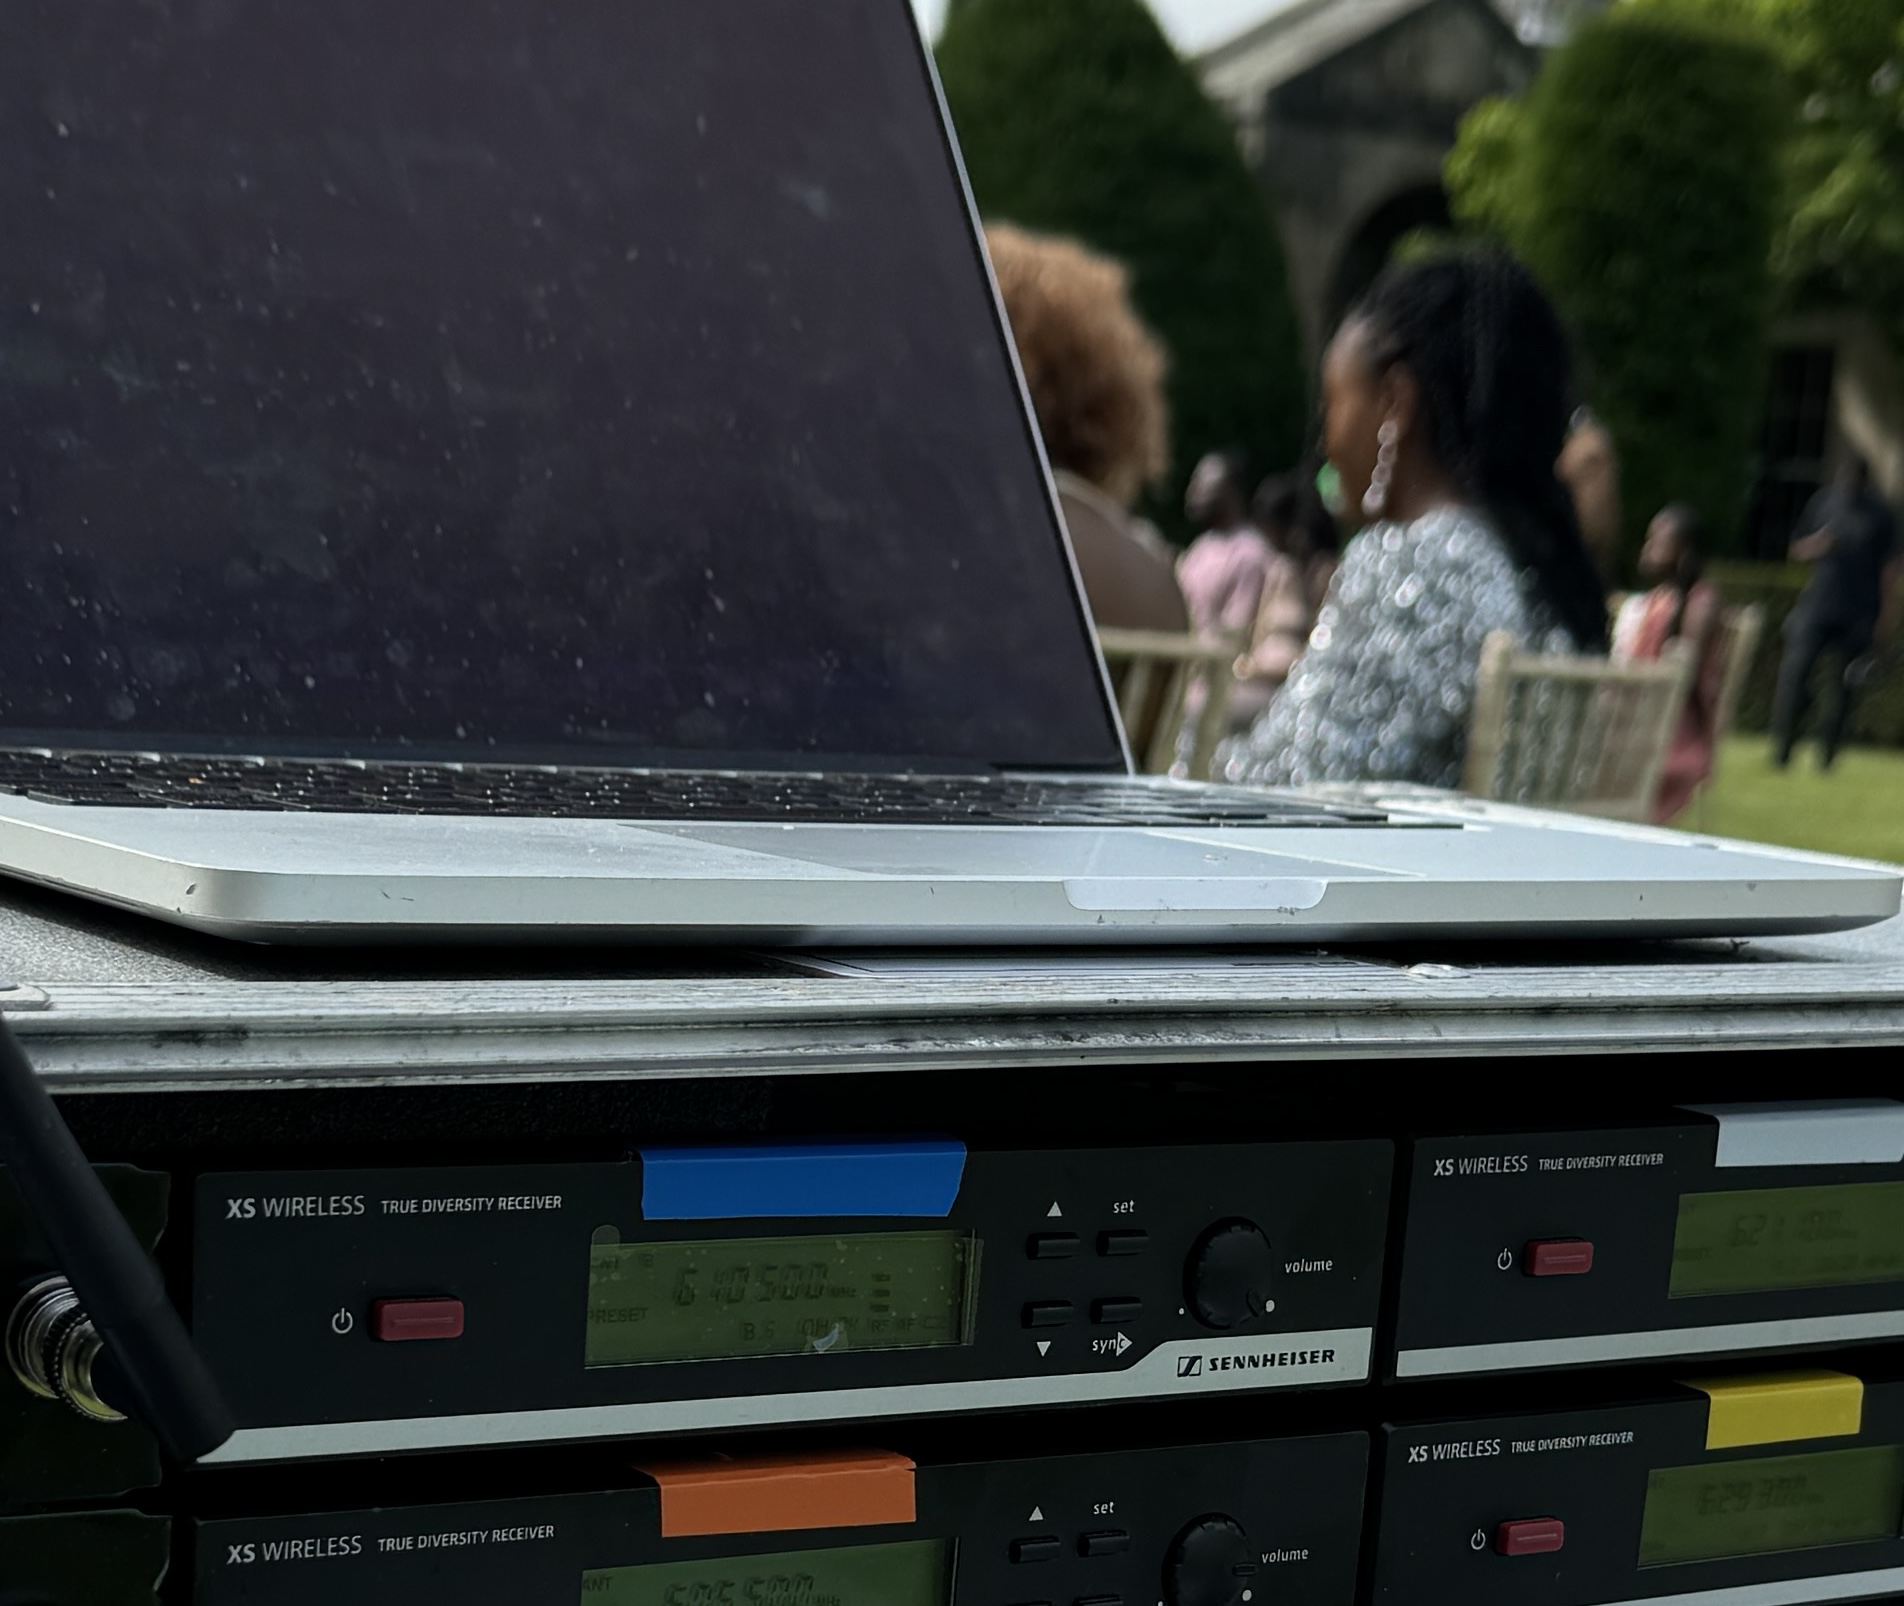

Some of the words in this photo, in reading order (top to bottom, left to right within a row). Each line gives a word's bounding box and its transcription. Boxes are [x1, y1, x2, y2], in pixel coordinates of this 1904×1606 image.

[1433, 1158, 1454, 1177] XS
[1458, 1155, 1528, 1175] WIRELESS
[1538, 1157, 1564, 1171] TRUE
[1566, 1155, 1616, 1170] DIVERSITY
[1617, 1153, 1664, 1167] RECEIVER
[226, 1197, 256, 1219] XS
[262, 1195, 365, 1218] WIRELESS
[381, 1199, 418, 1214] TRUE
[422, 1197, 495, 1213] DIVERSITY
[498, 1195, 562, 1210] RECEIVER
[1113, 1199, 1135, 1214] set
[1284, 1258, 1333, 1274] volume
[1208, 1349, 1335, 1372] SENNHEISER
[1408, 1445, 1429, 1464] XS
[1432, 1438, 1501, 1461] WIRELESS
[1511, 1439, 1536, 1454] TRUE
[1537, 1435, 1588, 1451] DIVERSITY
[1588, 1431, 1634, 1446] RECEIVER
[1093, 1501, 1114, 1515] set
[227, 1543, 256, 1564] XS
[262, 1535, 362, 1561] WIRELESS
[377, 1536, 414, 1552] TRUE
[417, 1530, 489, 1549] DIVERSITY
[491, 1525, 554, 1542] RECEIVER
[1261, 1548, 1309, 1564] volume
